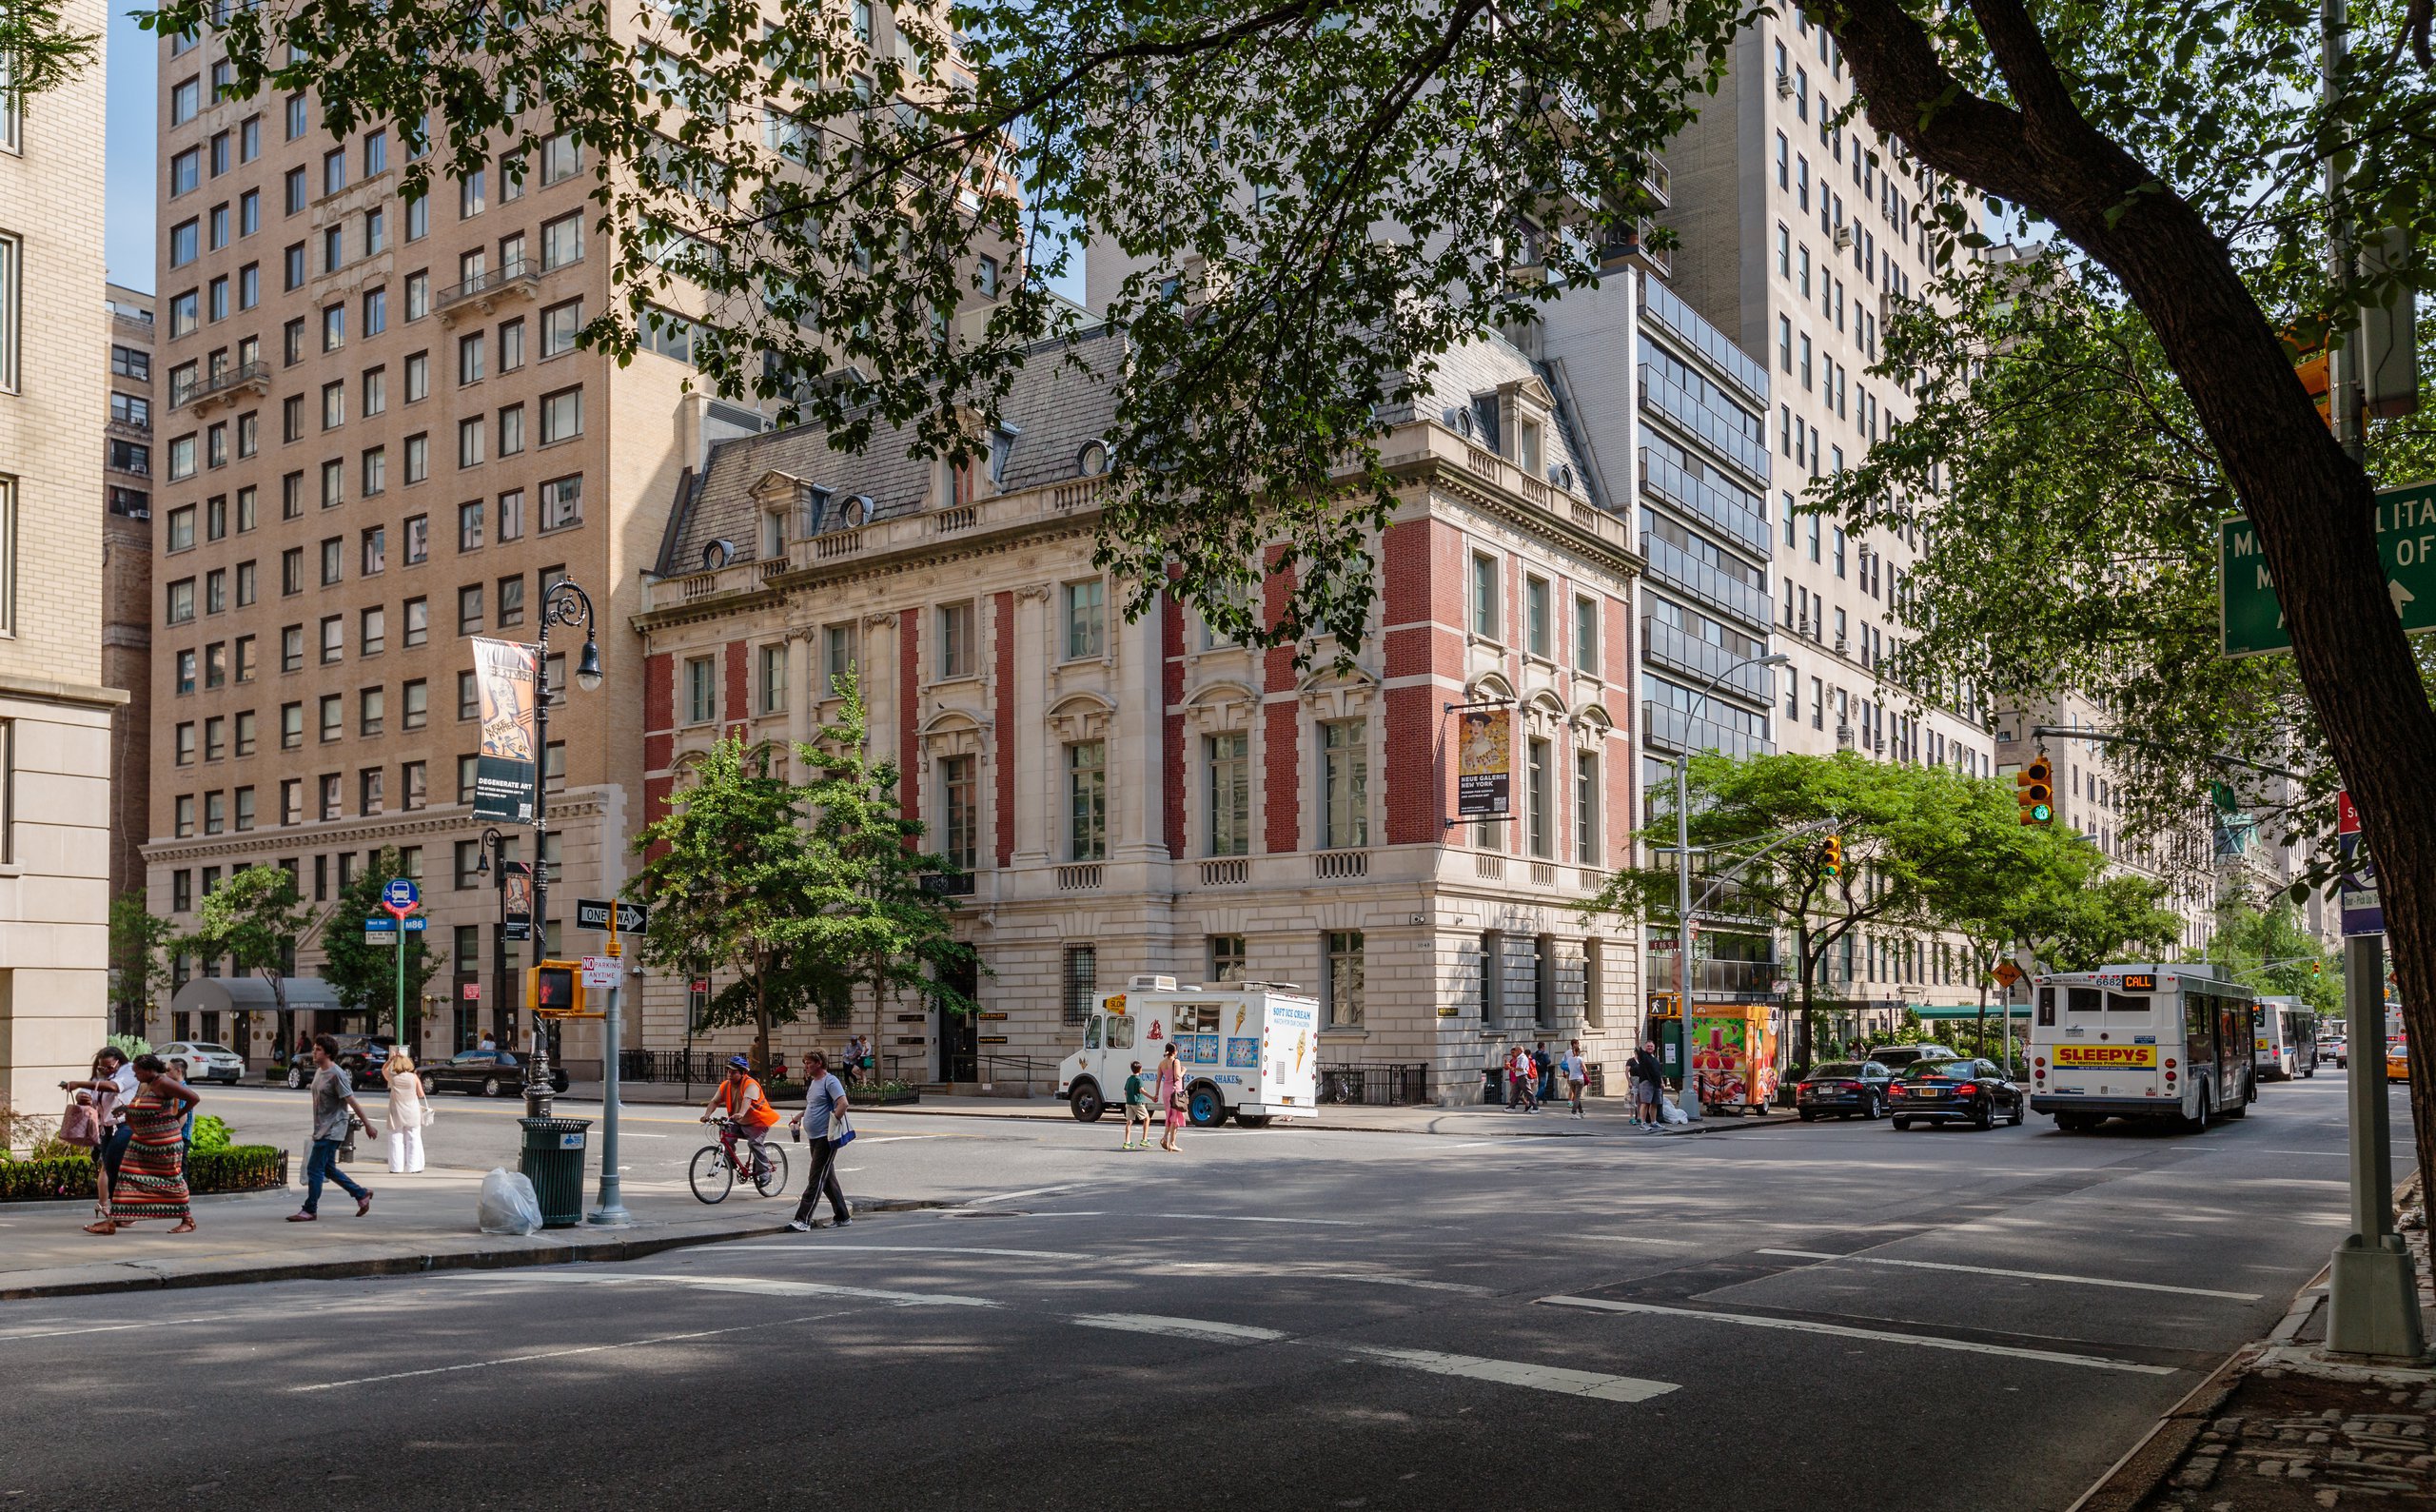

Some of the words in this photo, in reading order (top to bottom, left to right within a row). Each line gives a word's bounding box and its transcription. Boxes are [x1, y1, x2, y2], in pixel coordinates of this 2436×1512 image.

[2396, 535, 2435, 566] OF
[478, 777, 520, 789] DEGENERATE
[2356, 895, 2366, 904] Pick
[586, 909, 607, 921] ONE
[616, 912, 637, 924] WAY
[405, 920, 423, 929] M86
[583, 957, 594, 970] NO
[595, 961, 621, 970] PARKING
[2095, 978, 2122, 987] 6682
[2126, 975, 2151, 987] CALL
[1273, 1007, 1285, 1017] SOFT
[1294, 1010, 1311, 1020] CREAM
[1214, 1074, 1239, 1084] SHAKES
